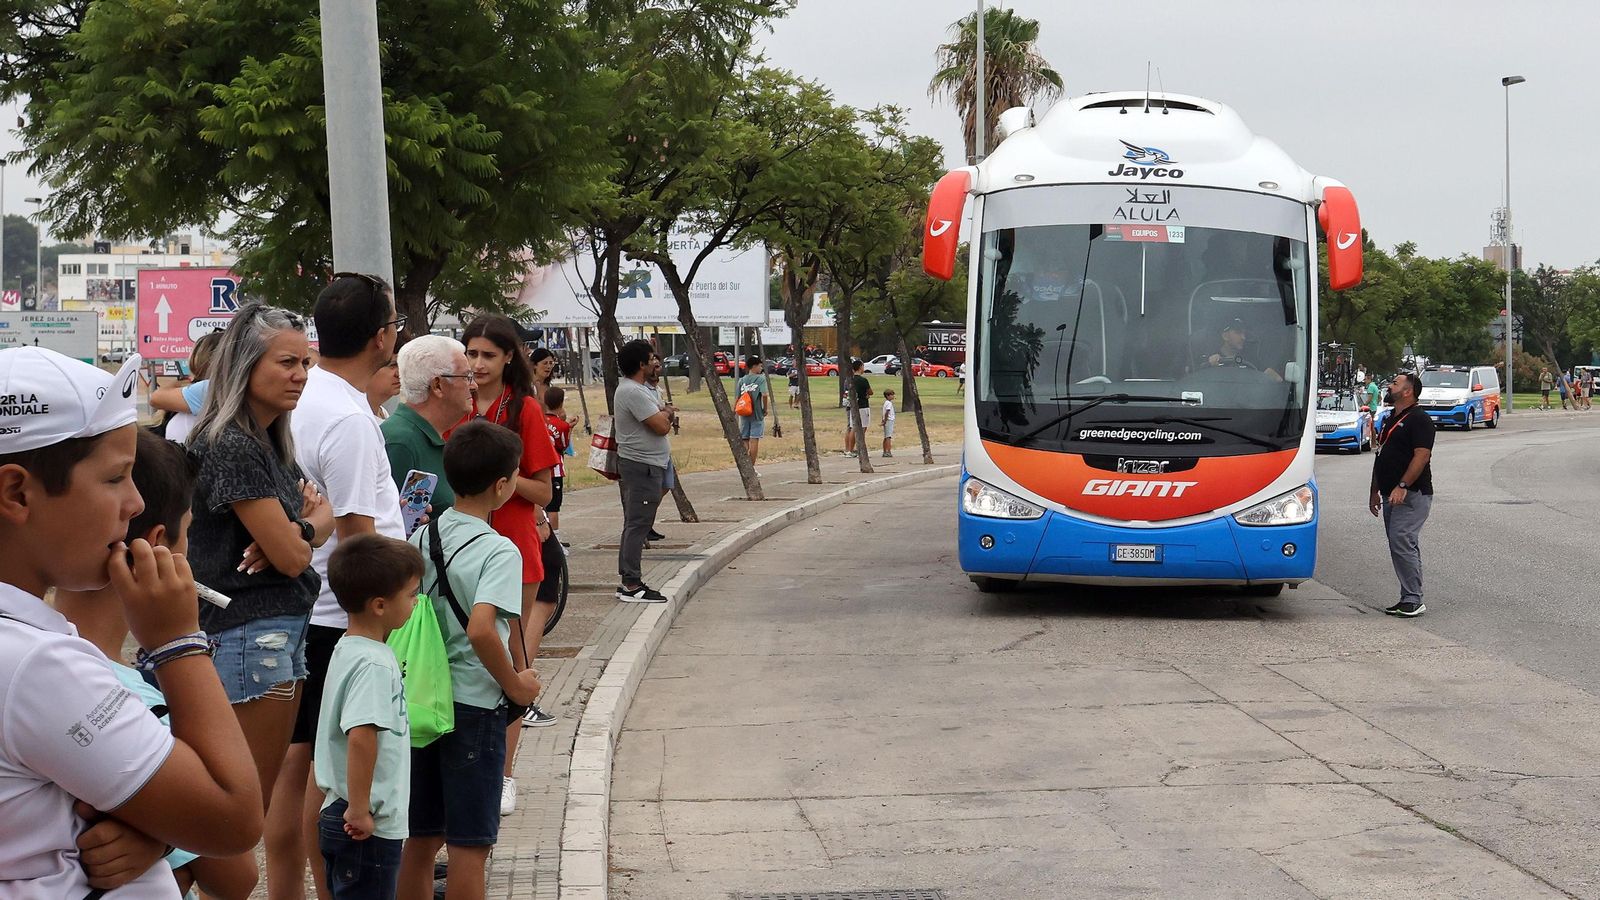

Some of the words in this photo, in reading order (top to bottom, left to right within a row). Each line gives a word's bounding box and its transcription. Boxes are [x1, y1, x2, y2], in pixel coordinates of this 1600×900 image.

[1108, 164, 1184, 180] Jayco
[1113, 206, 1180, 221] ALULA
[1132, 229, 1158, 237] EQUIPOS
[696, 282, 716, 290] Puerta
[718, 282, 727, 290] del
[729, 282, 740, 290] Sur
[928, 332, 966, 345] INEOS
[21, 393, 39, 404] LA
[0, 404, 49, 416] NDIALE
[1080, 428, 1202, 441] greenedgecycling.com
[1082, 480, 1199, 497] GIANT
